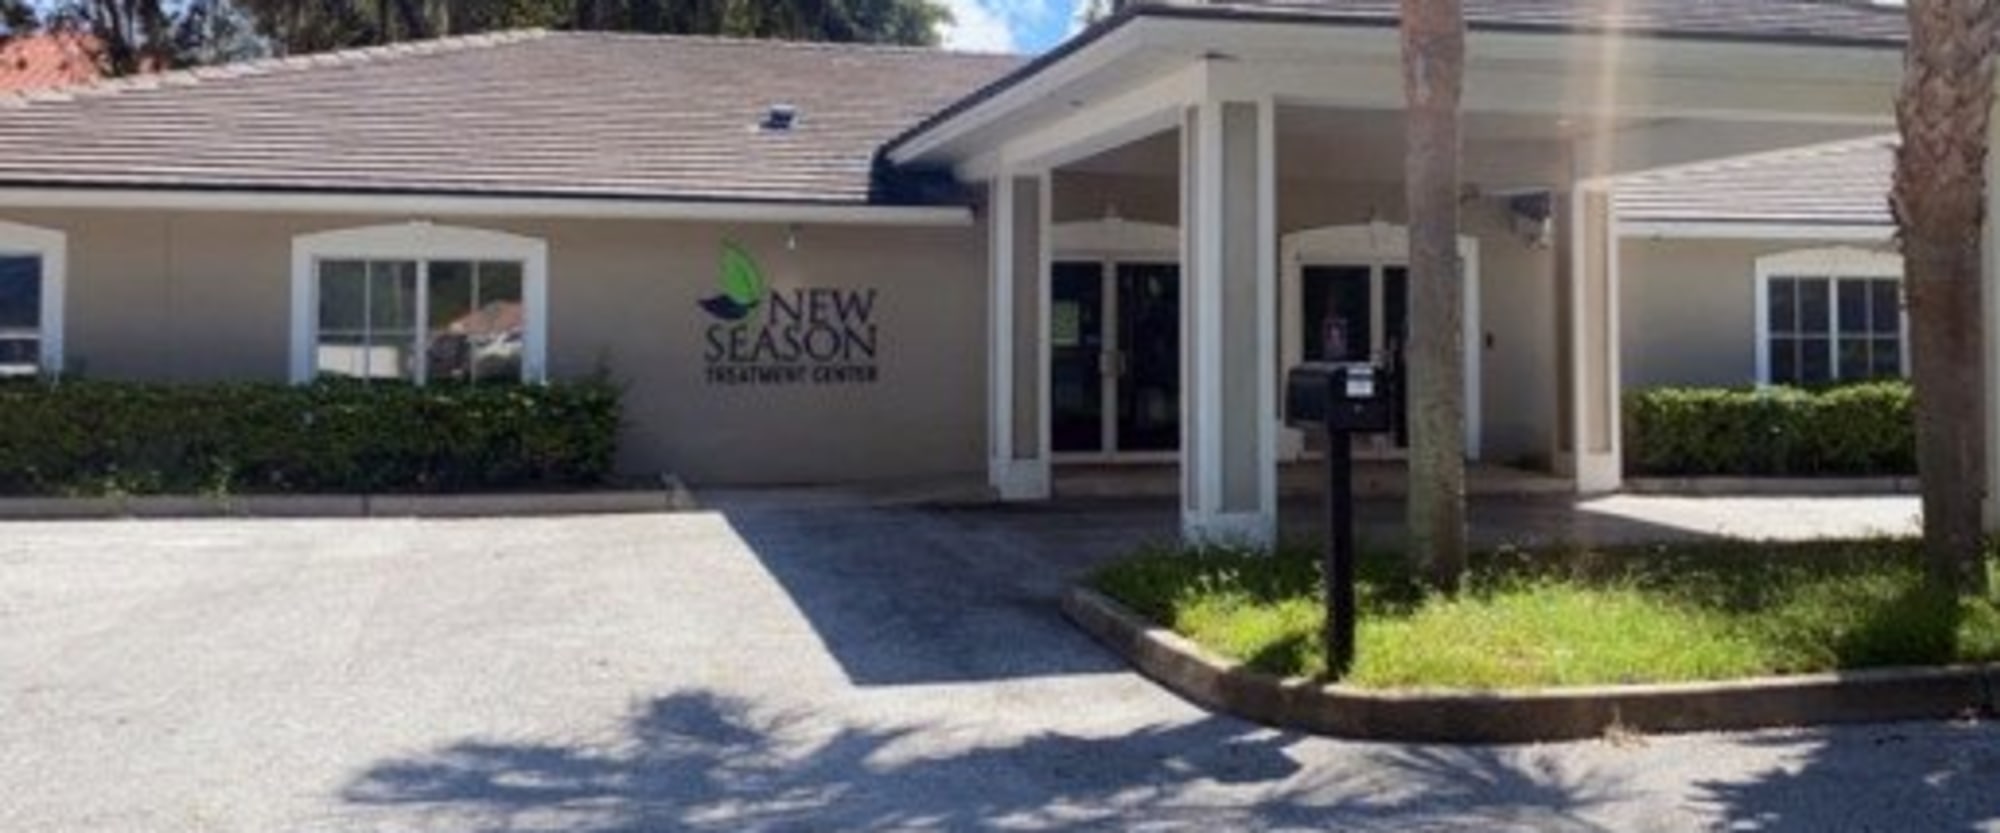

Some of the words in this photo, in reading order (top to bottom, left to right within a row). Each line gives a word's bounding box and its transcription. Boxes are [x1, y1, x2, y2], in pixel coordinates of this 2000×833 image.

[768, 288, 877, 325] NEW
[705, 323, 877, 362] SEASON
[705, 366, 805, 384] TREATMENT
[812, 366, 877, 384] CENTER
